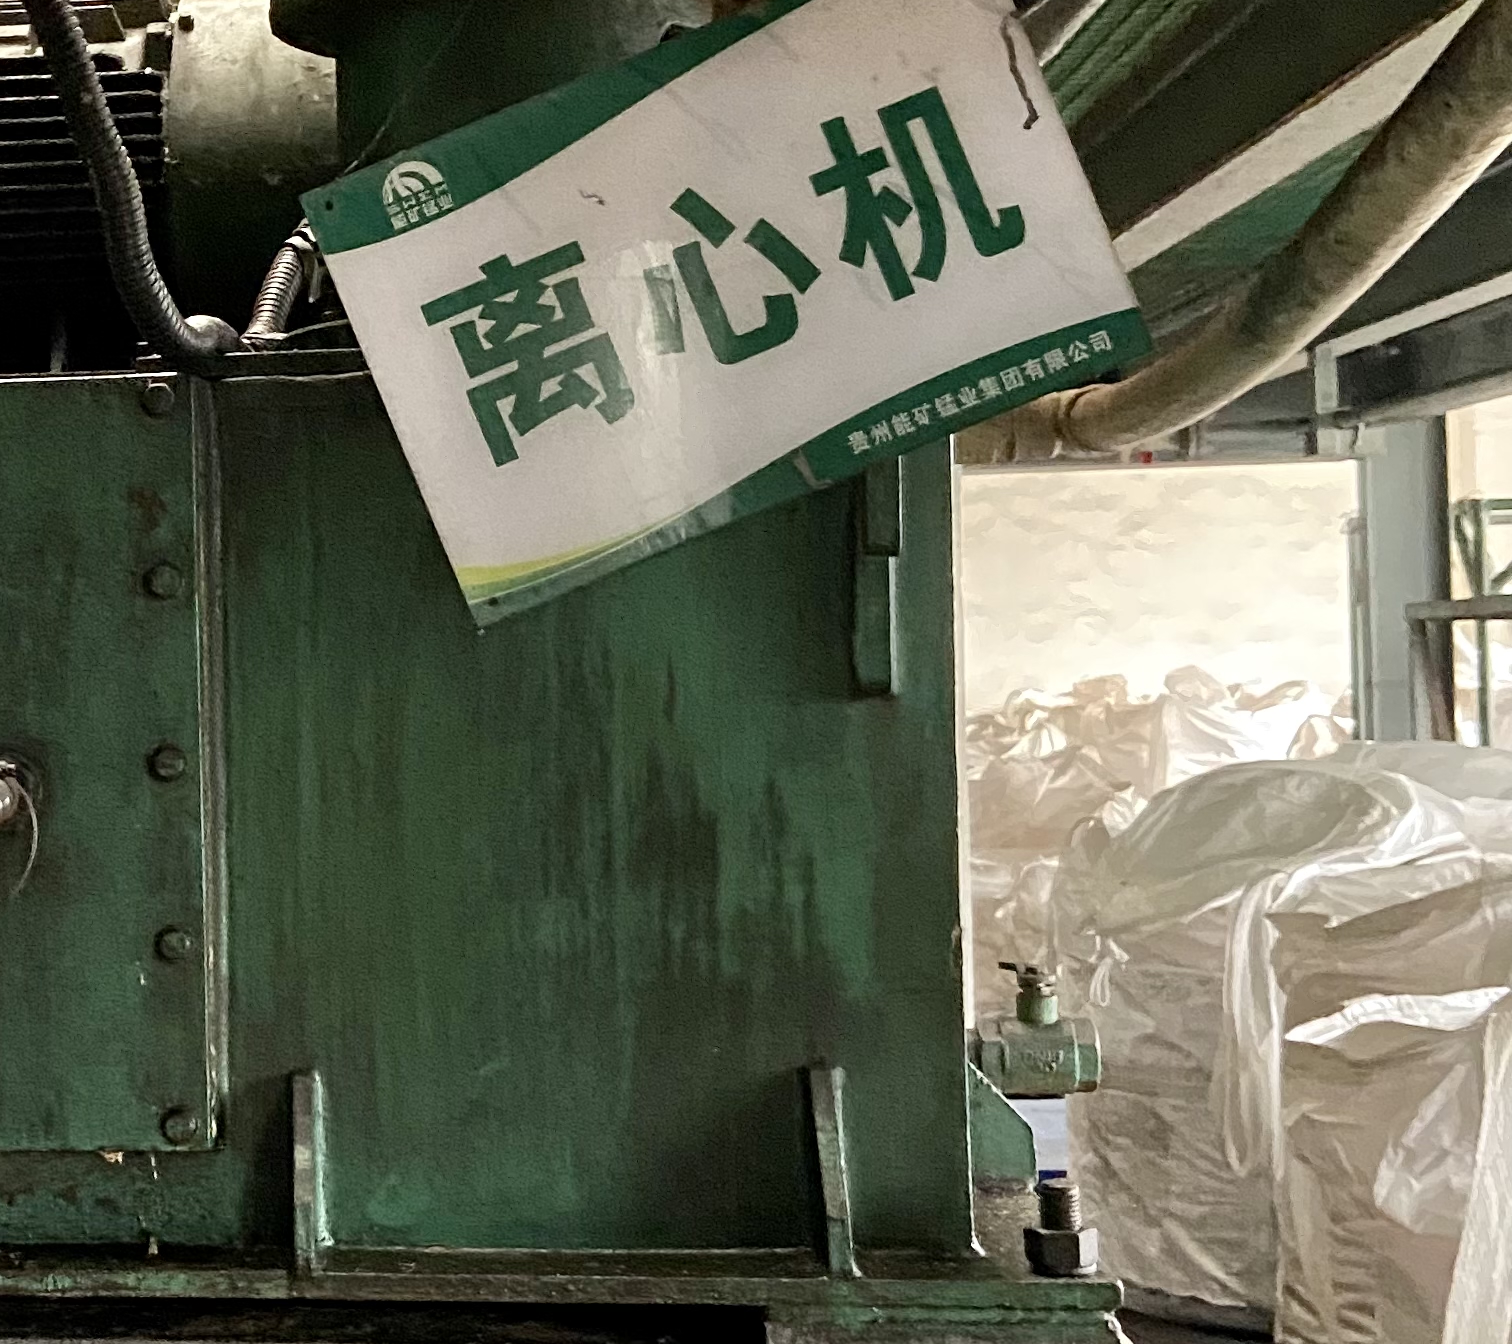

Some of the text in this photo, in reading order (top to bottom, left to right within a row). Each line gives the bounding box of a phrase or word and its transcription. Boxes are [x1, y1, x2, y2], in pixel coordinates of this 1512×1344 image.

[420, 86, 1024, 467] 离心机
[847, 329, 1113, 455] 贵州能矿锰业集团有限公司
